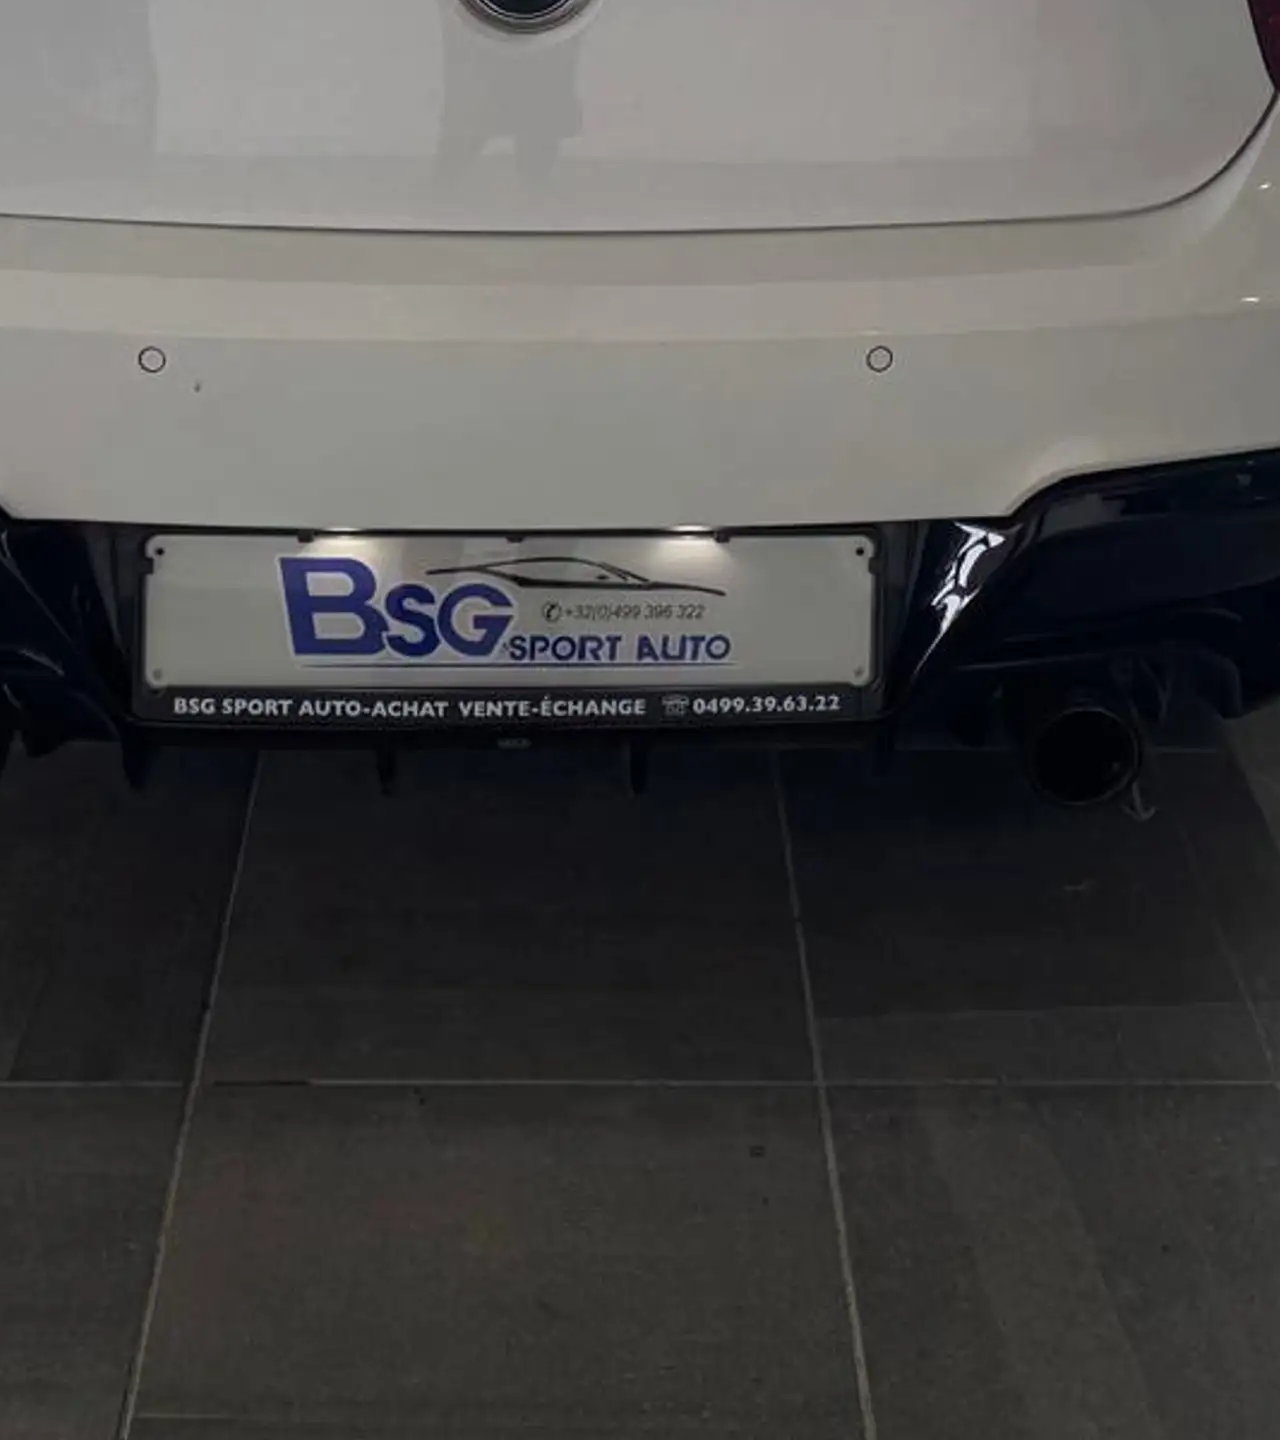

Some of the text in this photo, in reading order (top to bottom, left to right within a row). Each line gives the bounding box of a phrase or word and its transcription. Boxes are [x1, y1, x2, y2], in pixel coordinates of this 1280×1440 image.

[278, 556, 514, 657] BSG
[508, 633, 731, 662] SPORT AUTO
[173, 697, 216, 715] BSG
[222, 698, 293, 716] SPORT
[692, 694, 841, 715] 0499.39.63.22
